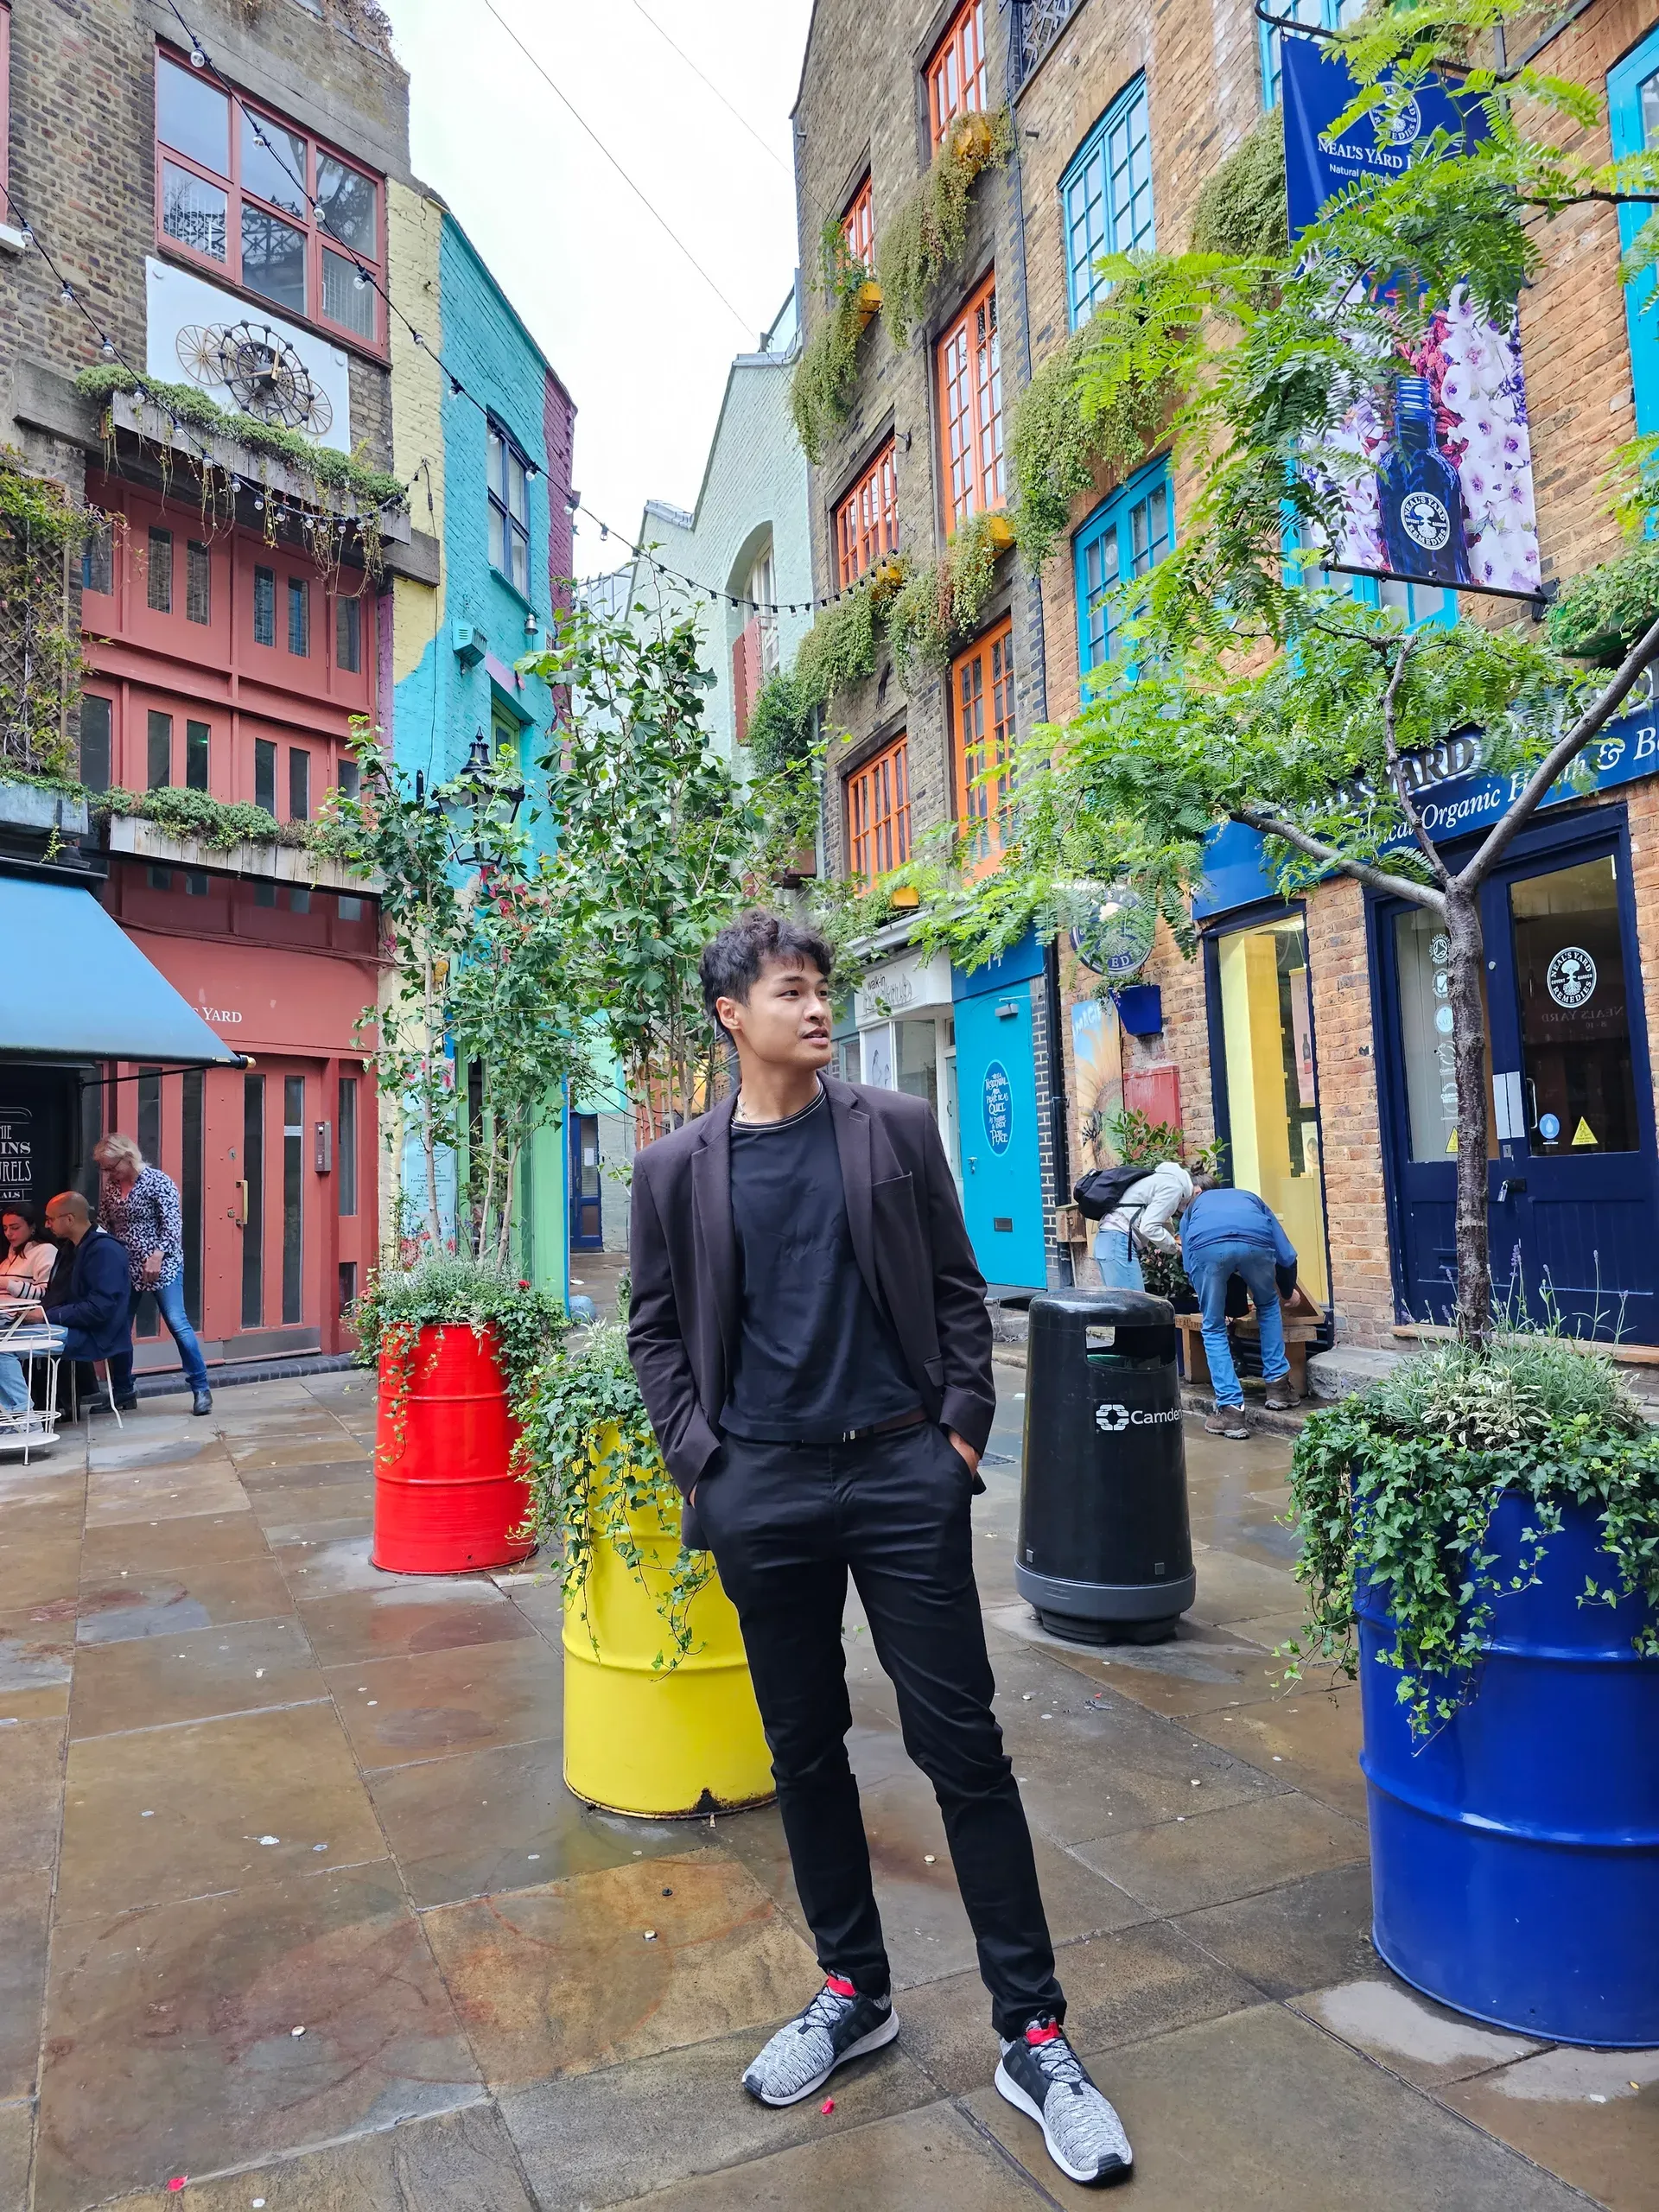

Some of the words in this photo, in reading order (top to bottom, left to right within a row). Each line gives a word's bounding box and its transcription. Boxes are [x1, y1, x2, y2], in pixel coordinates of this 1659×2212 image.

[1364, 148, 1403, 169] YARD
[1329, 163, 1359, 178] Natural
[1404, 496, 1427, 517] NEAL'S
[1427, 498, 1446, 522] YARD
[1408, 524, 1446, 546] REMEDIES
[1421, 783, 1502, 830] Organic
[1551, 951, 1573, 978] NEAL'S
[1573, 951, 1592, 972] YARD
[1553, 980, 1592, 1003] REMEDIES
[202, 1006, 243, 1023] YARD
[1130, 1408, 1183, 1425] Camden
